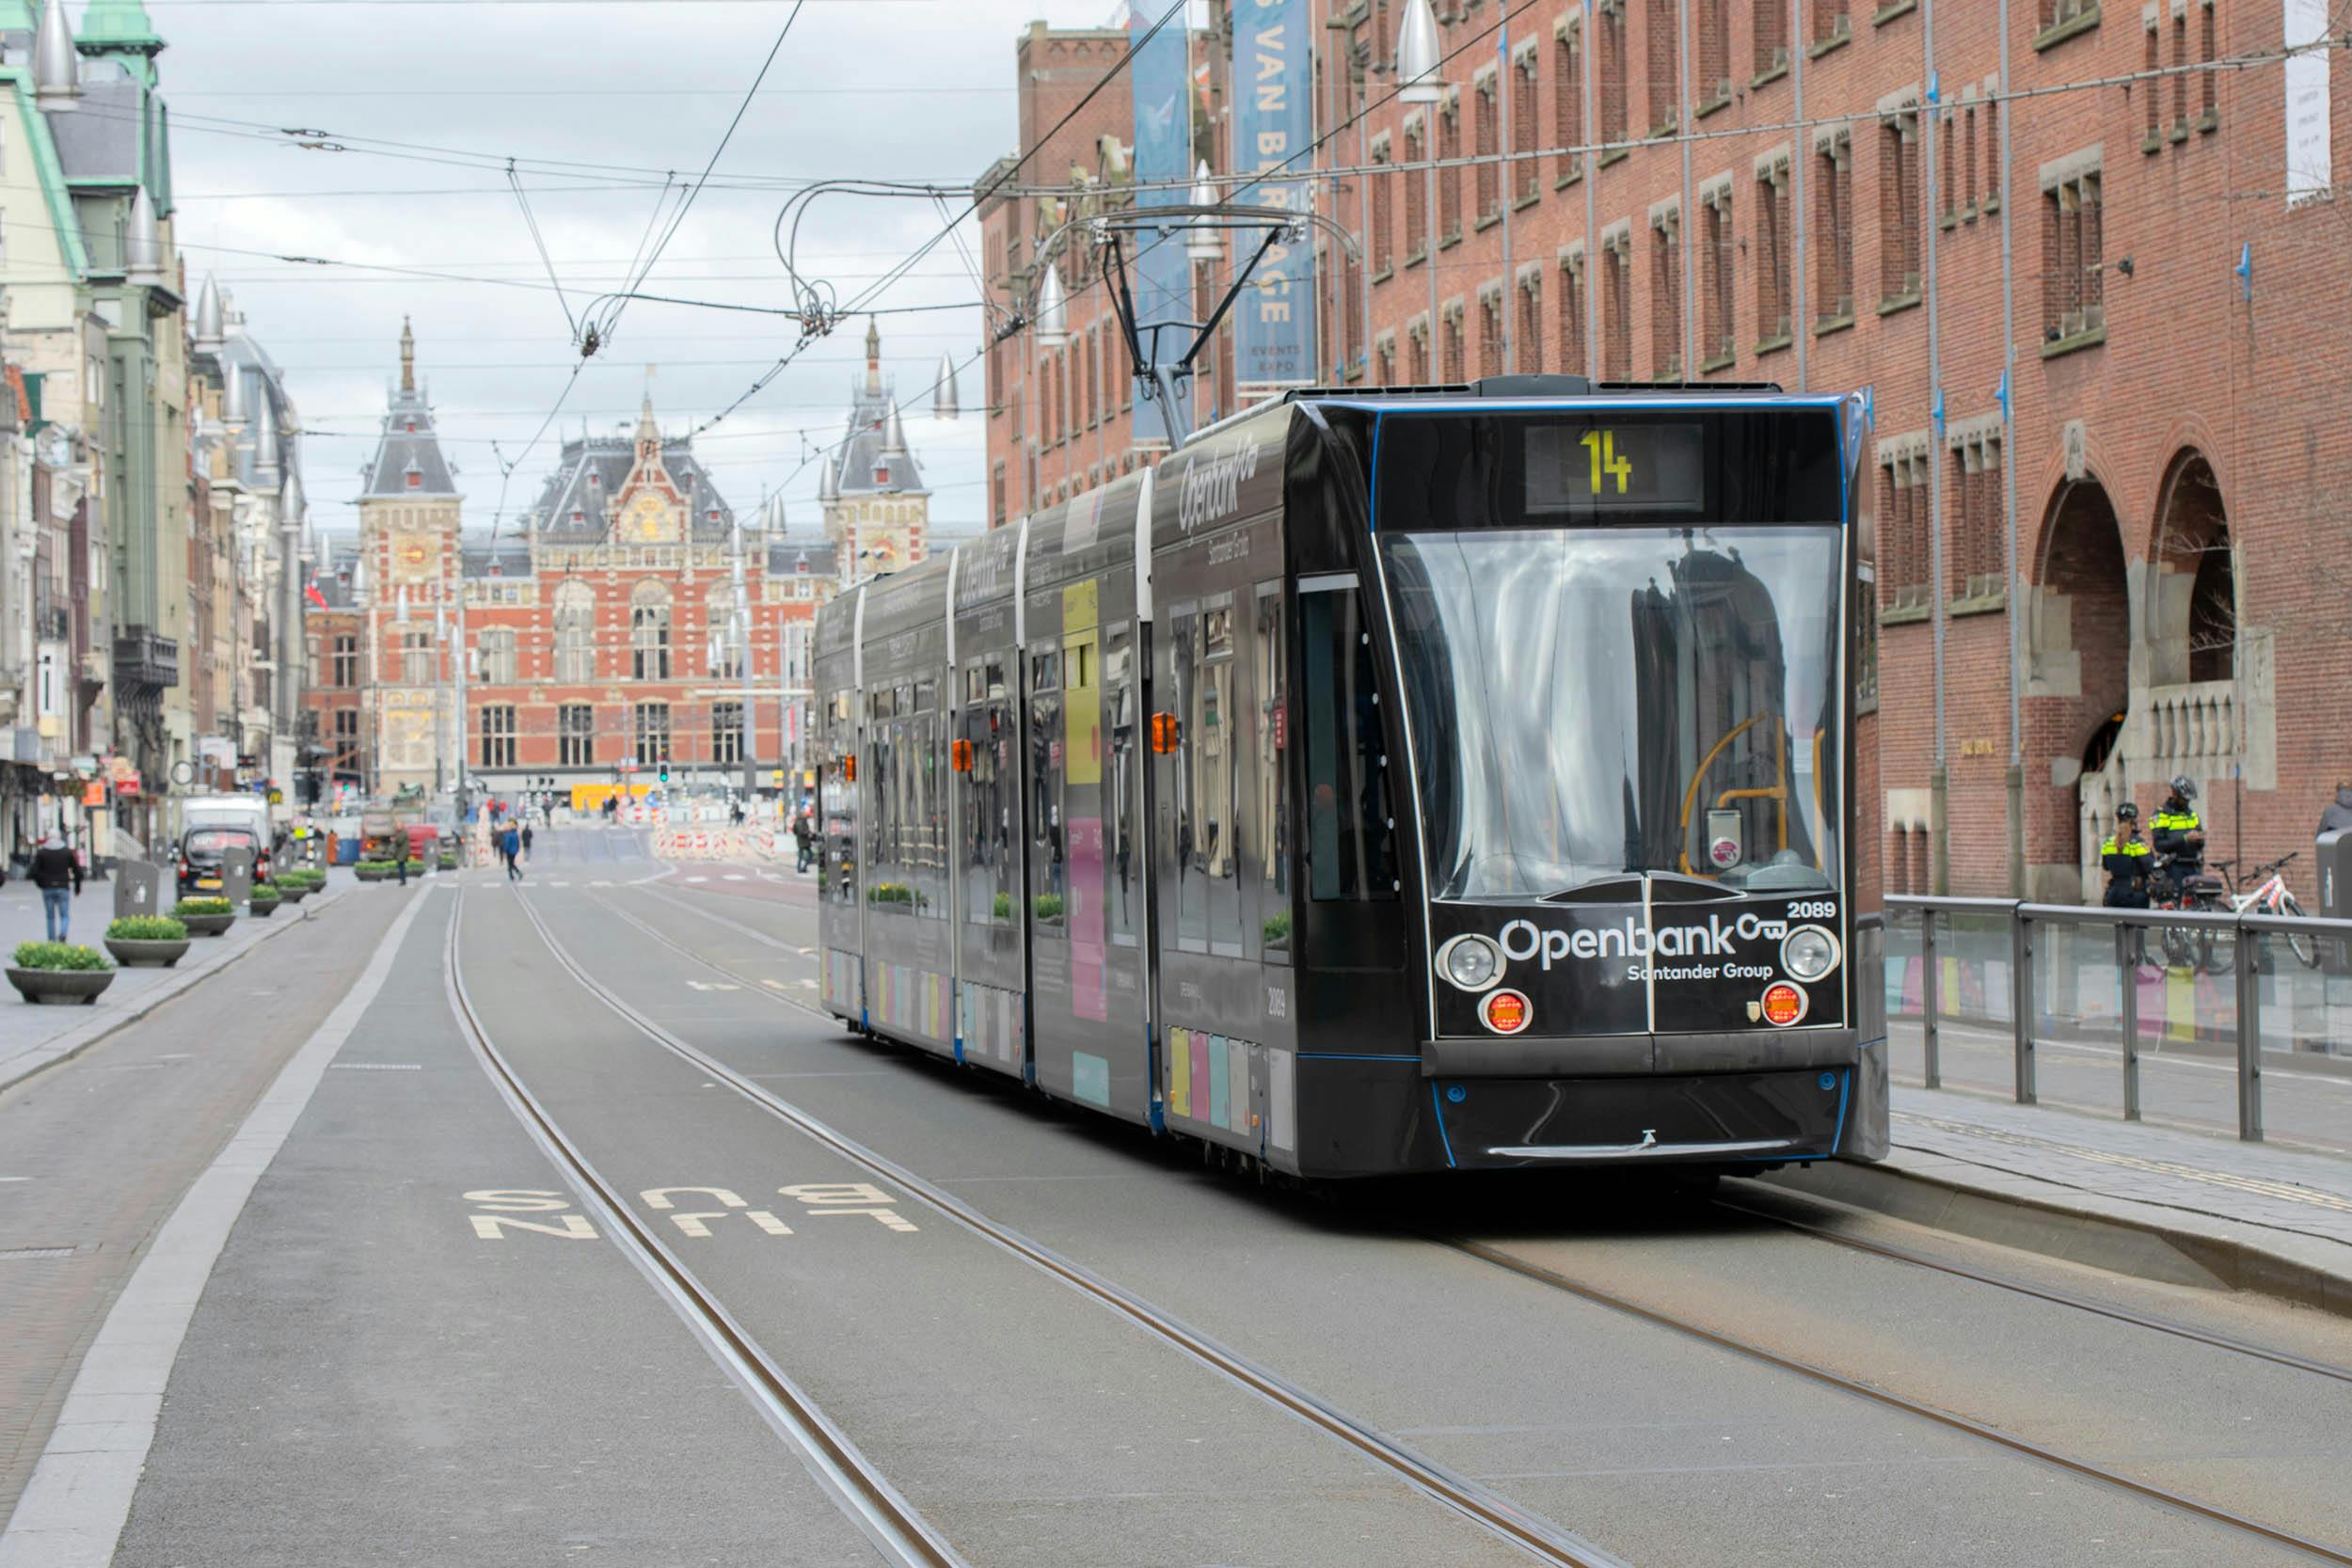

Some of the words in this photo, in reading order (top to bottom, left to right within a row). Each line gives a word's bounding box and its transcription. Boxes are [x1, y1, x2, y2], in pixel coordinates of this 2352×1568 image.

[1255, 24, 1286, 112] VAN
[1580, 430, 1632, 494] 14
[1787, 901, 1836, 919] 2089
[1499, 913, 1737, 971] Openbank
[1627, 962, 1720, 981] Santander
[1723, 962, 1773, 981] Group
[1267, 988, 1286, 1018] 2089
